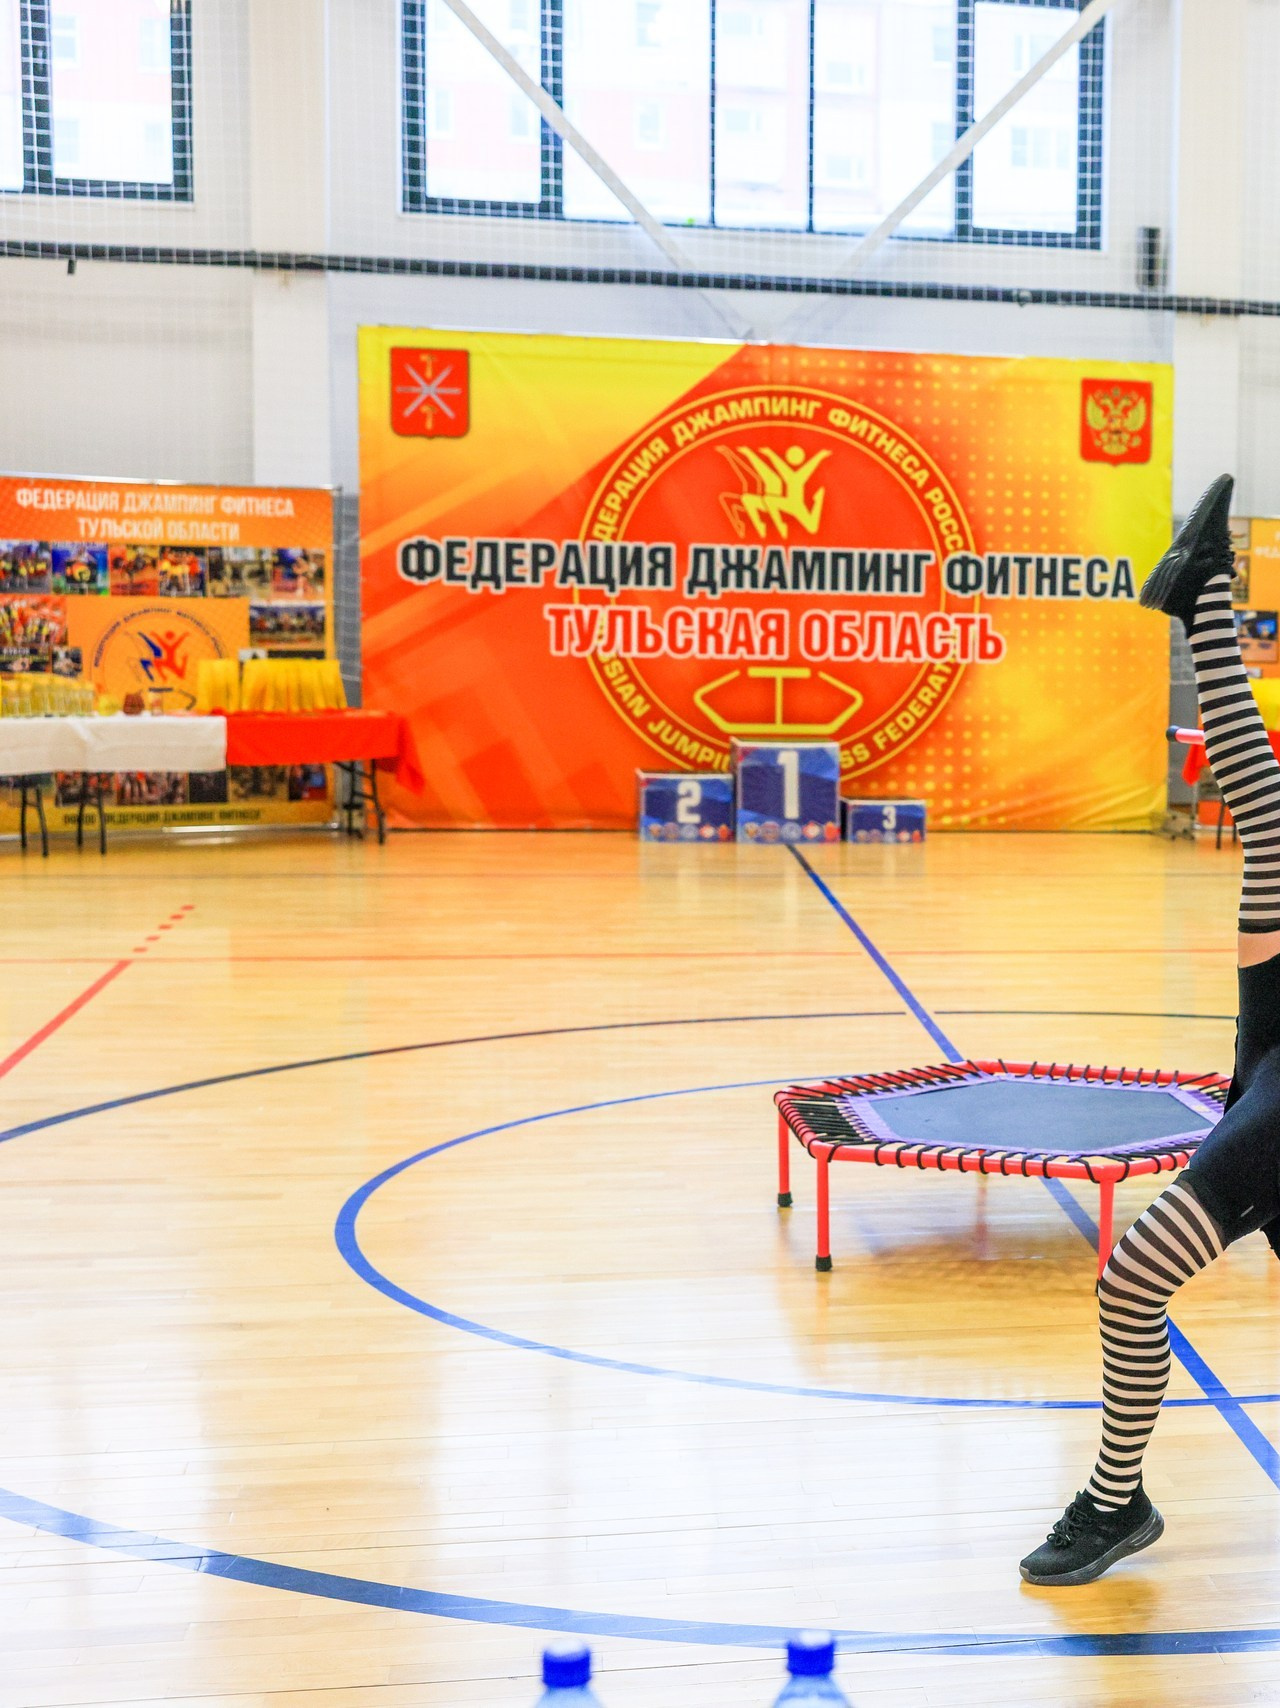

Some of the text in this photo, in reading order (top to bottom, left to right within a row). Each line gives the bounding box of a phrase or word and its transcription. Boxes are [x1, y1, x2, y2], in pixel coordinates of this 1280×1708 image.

[592, 396, 965, 552] ДЕРАЦИЯ ДЖАМПИНГ ФИТНЕСА РОСС
[16, 487, 295, 518] ФЕДЕРАЦИЯ ДЖАМПИНГ ФИТНЕСА
[78, 516, 240, 541] ТУЛЬСКОЙ ОБЛАСТИ
[400, 537, 1136, 600] ФЕДЕРАЦИЯ ДЖАМПИНГ ФИТНЕСА
[545, 604, 1006, 663] ТУЛЬСКАЯ ОБЛАСТЬ
[871, 660, 954, 751] FEDERAT
[646, 719, 732, 771] JUMPI
[676, 781, 702, 824] 2
[777, 750, 799, 820] 1
[882, 806, 897, 830] 3
